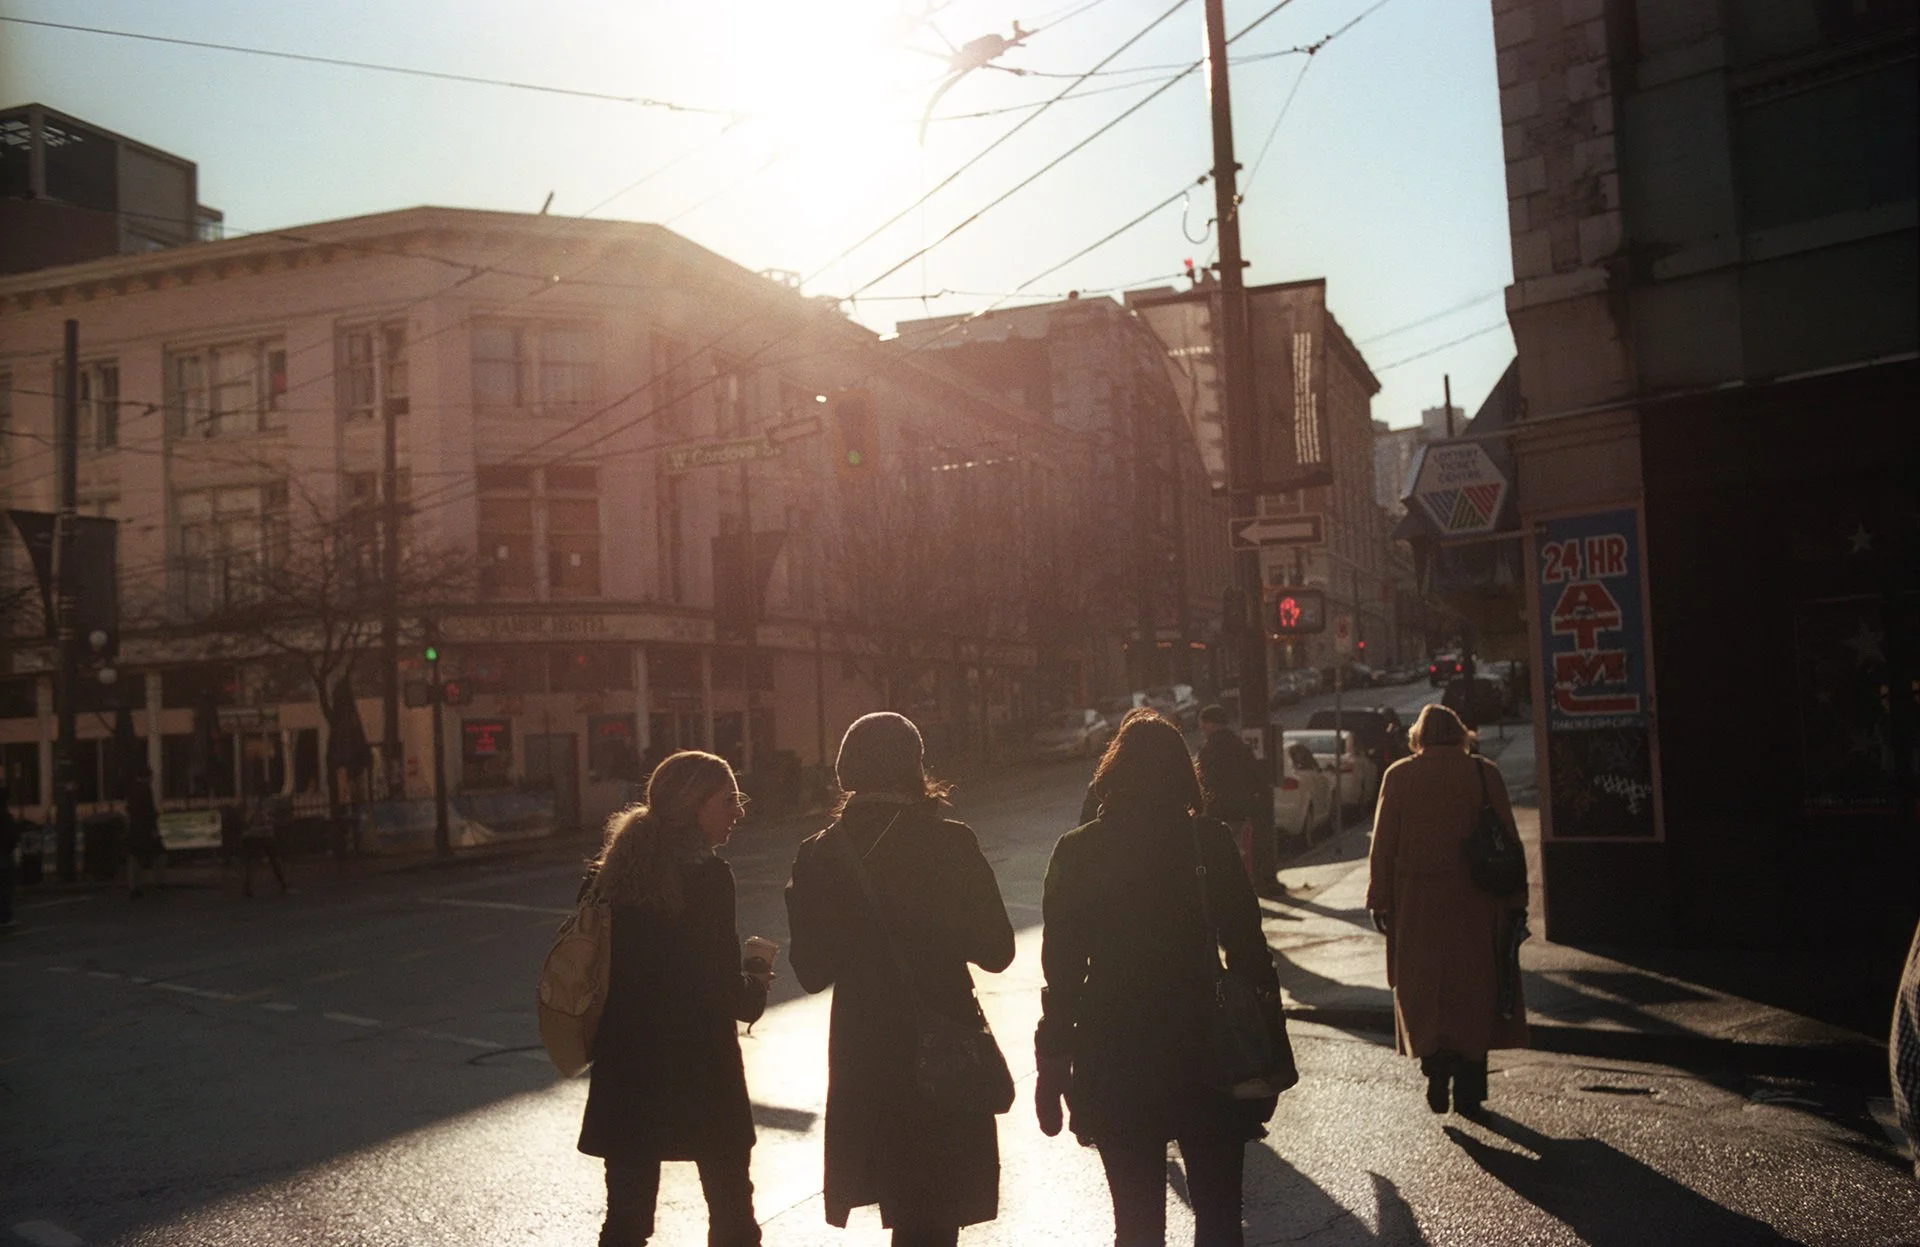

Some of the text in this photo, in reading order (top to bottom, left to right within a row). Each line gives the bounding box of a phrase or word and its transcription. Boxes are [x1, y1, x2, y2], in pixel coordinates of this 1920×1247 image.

[671, 452, 687, 468] W
[692, 445, 756, 464] Cordova
[1440, 459, 1477, 472] TICKET
[1541, 533, 1628, 584] 24 HR
[1551, 580, 1640, 715] ATM
